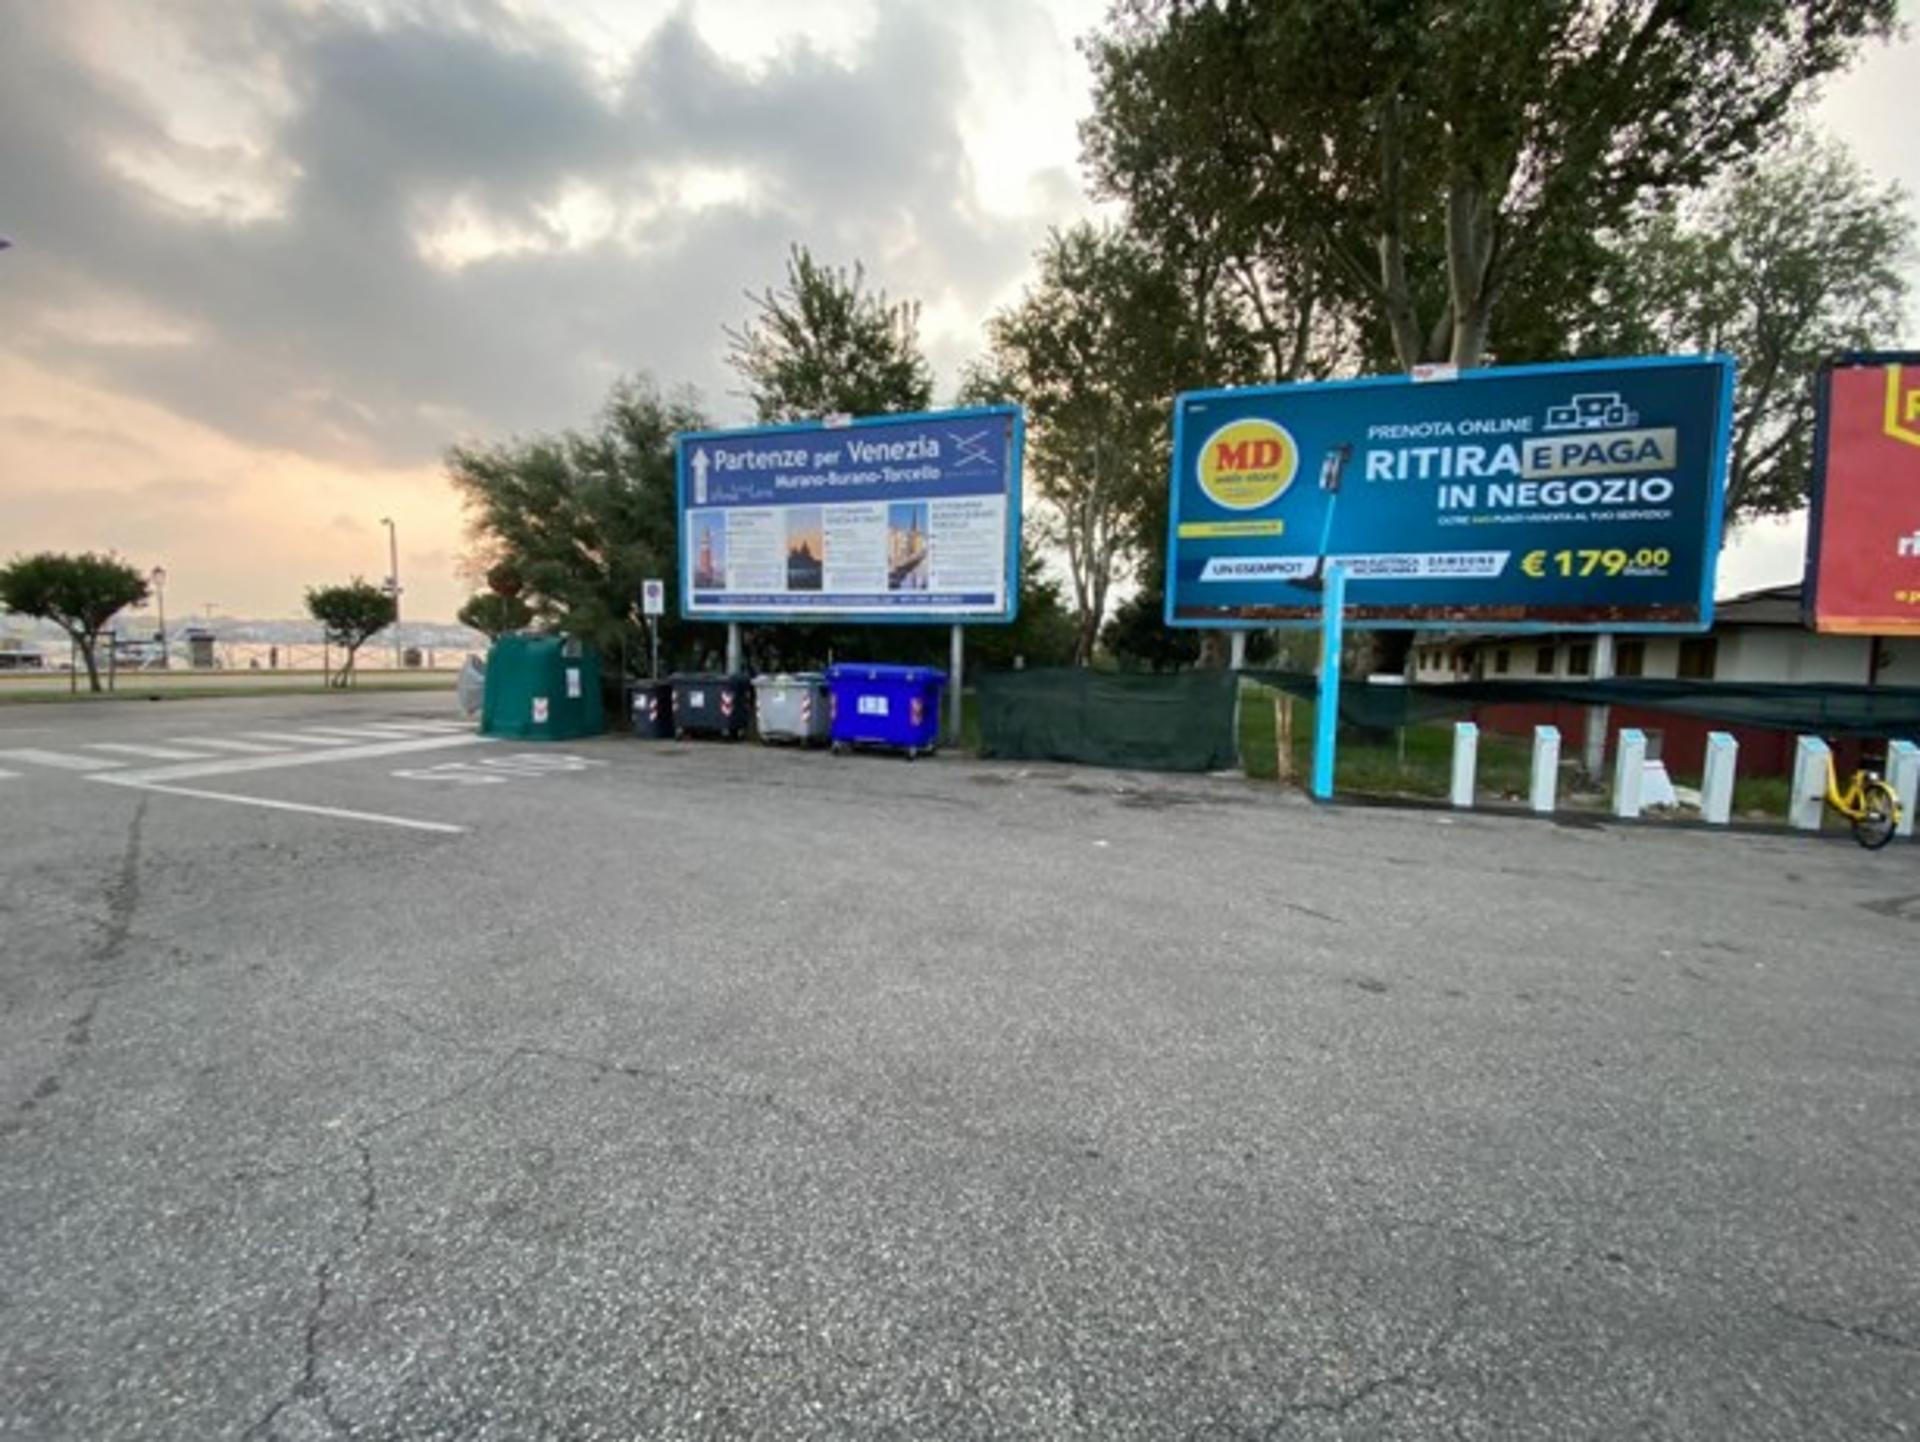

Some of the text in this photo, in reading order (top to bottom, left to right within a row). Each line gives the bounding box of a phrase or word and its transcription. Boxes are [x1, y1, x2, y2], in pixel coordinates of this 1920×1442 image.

[1368, 416, 1533, 440] PRENOTA ONLINE
[715, 434, 940, 472] Partenze per Venezia
[1215, 439, 1283, 471] MD
[1366, 438, 1664, 481] RITIRA E PAGA
[1438, 477, 1675, 510] IN NEGOZIO
[1521, 549, 1547, 577] €
